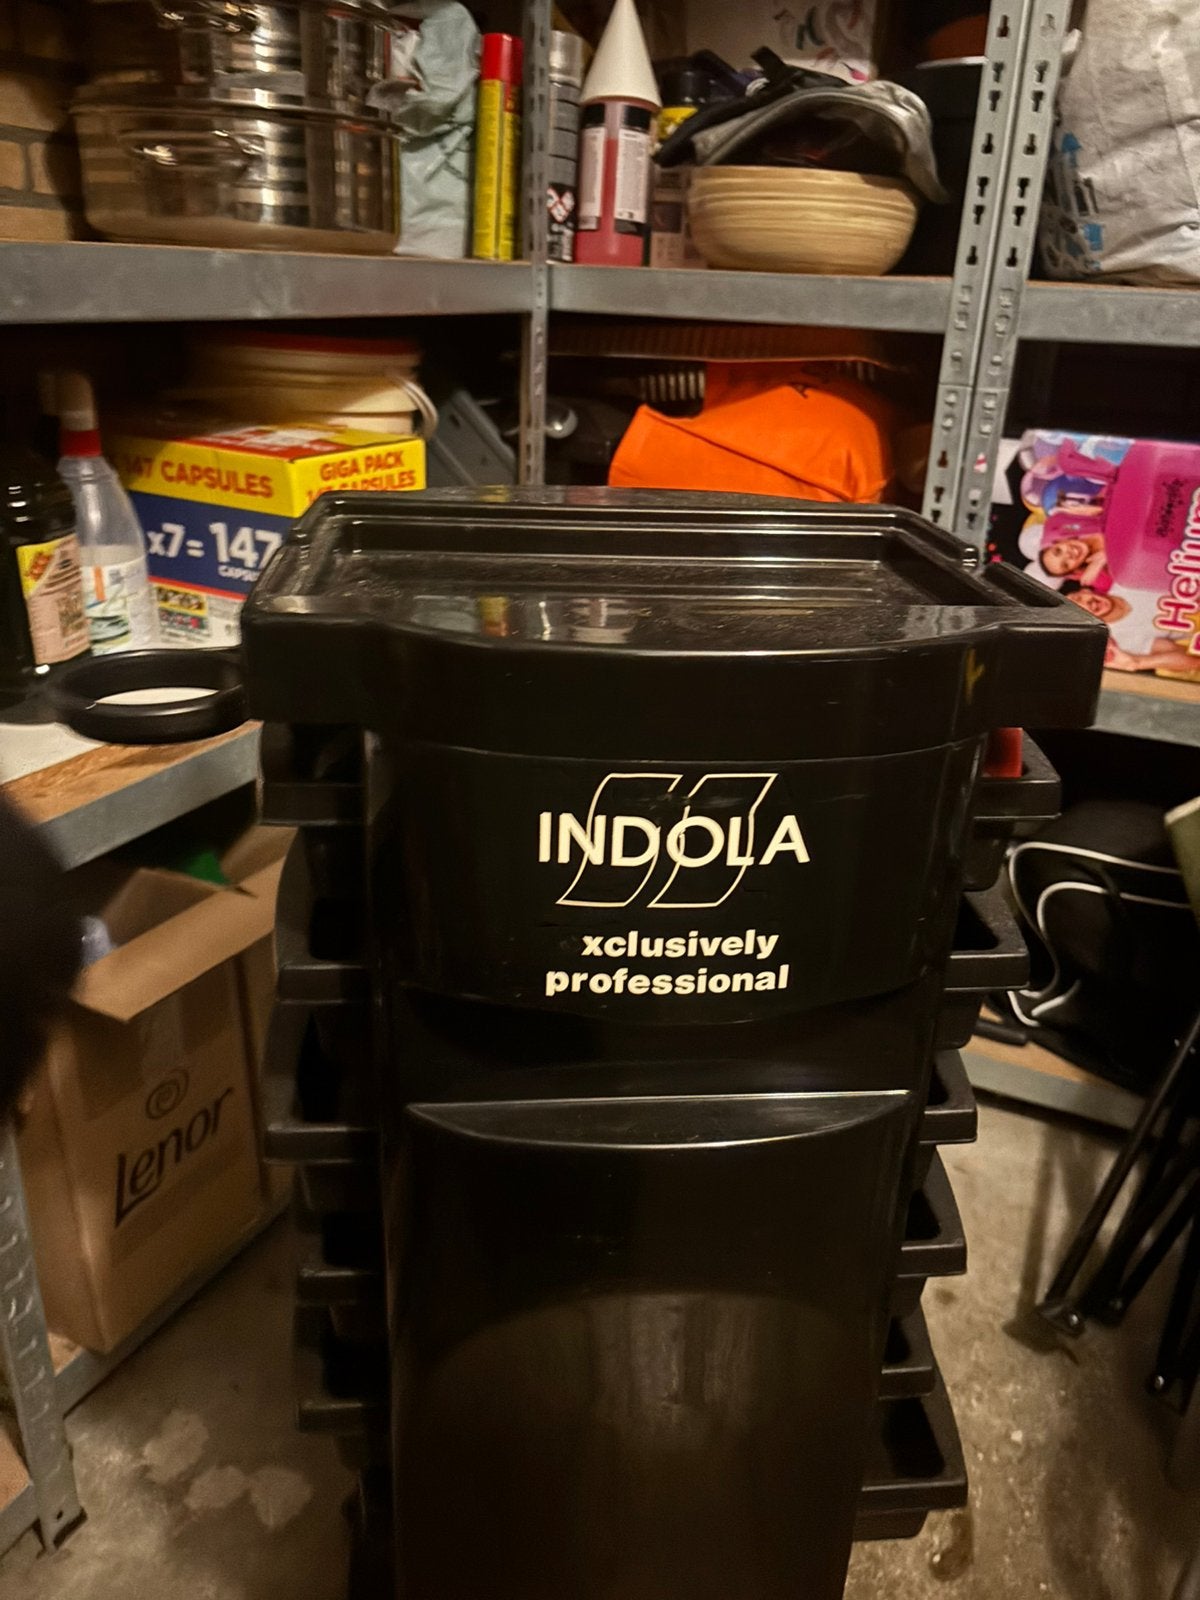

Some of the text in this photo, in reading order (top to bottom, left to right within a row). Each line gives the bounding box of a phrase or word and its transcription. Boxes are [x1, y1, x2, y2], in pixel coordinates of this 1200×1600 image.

[161, 460, 274, 499] CAPSULES
[320, 450, 404, 481] GIGA PACK
[209, 522, 283, 570] 147
[538, 811, 811, 867] INDOLA
[581, 929, 780, 959] xclusively
[545, 964, 790, 996] professional
[115, 1086, 234, 1229] Lenor
